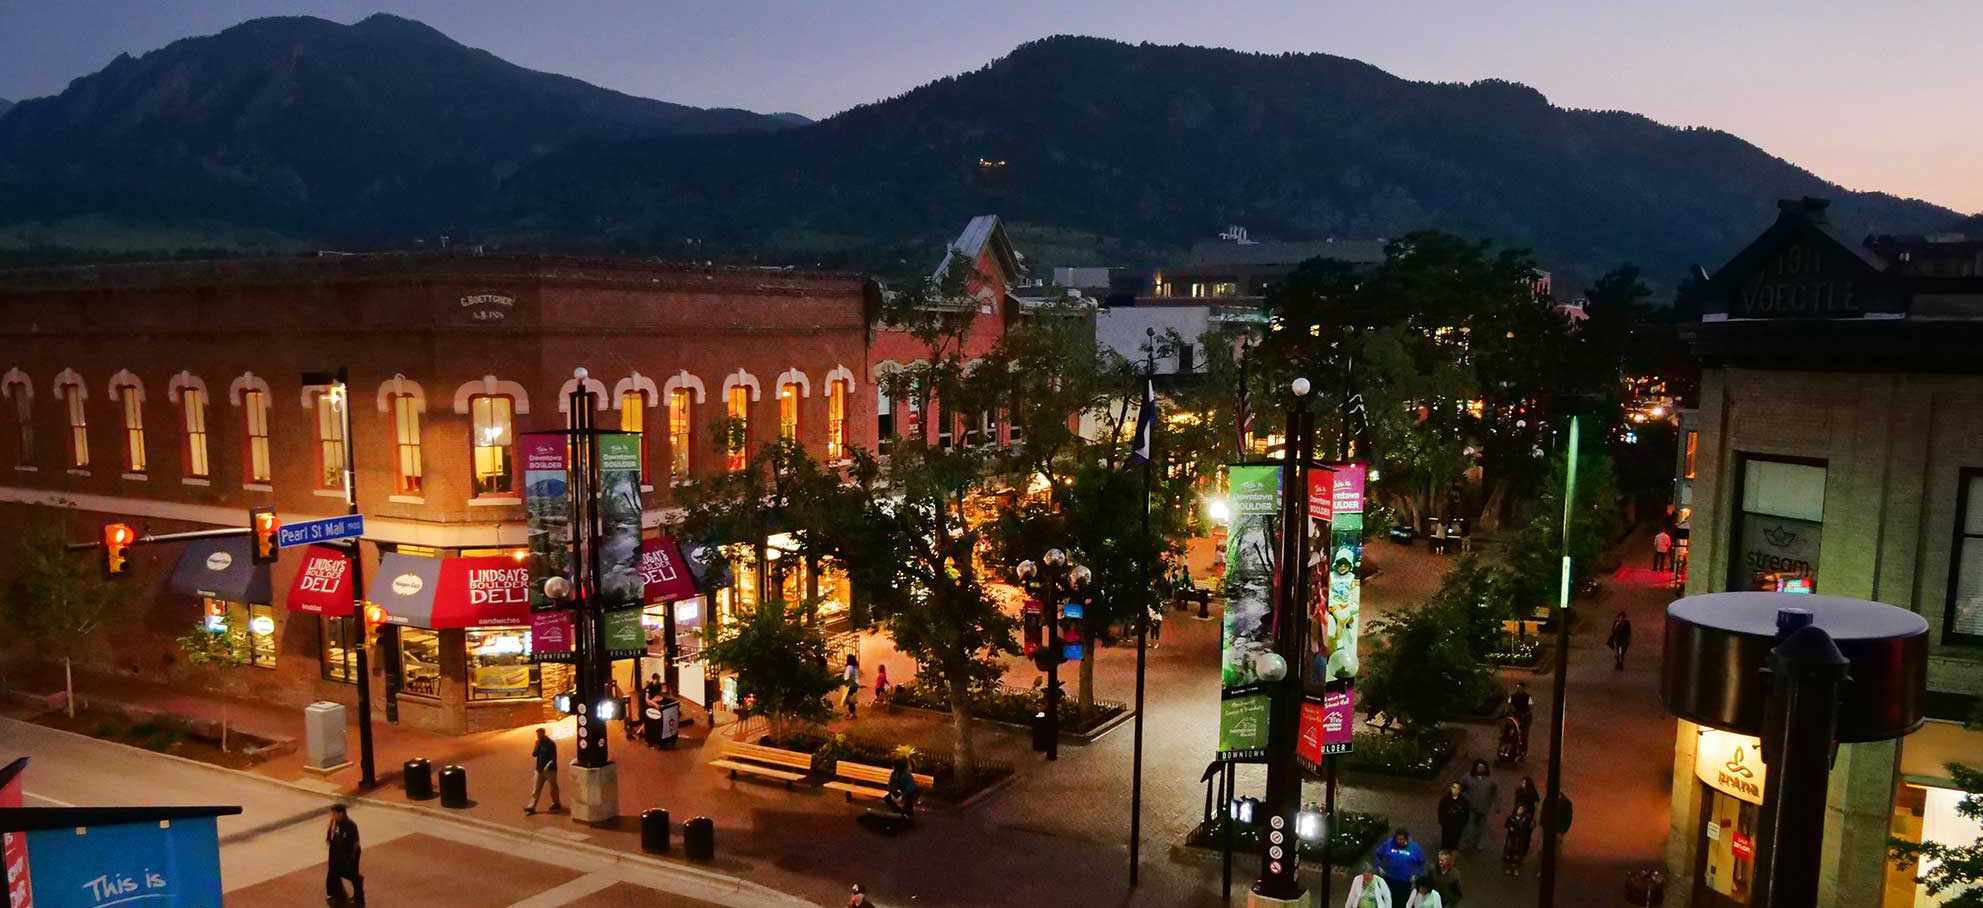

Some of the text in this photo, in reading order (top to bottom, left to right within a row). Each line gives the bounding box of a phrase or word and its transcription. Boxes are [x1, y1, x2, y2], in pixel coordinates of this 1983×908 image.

[1776, 243, 1825, 276] 1911
[1239, 502, 1273, 511] OULDER
[1333, 500, 1360, 509] ULDER
[281, 526, 308, 543] Pearl
[311, 524, 323, 539] St
[325, 521, 345, 536] Mall
[308, 557, 347, 573] LINDSAY'S
[1744, 551, 1809, 577] stream
[468, 567, 529, 582] LINDSAY'S
[300, 576, 341, 594] DELI
[469, 580, 529, 590] BOULDER
[470, 588, 529, 604] DELI
[478, 617, 521, 625] sandwiches
[1222, 751, 1265, 760] DOWNTOWN
[1321, 744, 1346, 753] ULDER
[82, 868, 167, 902] This is
